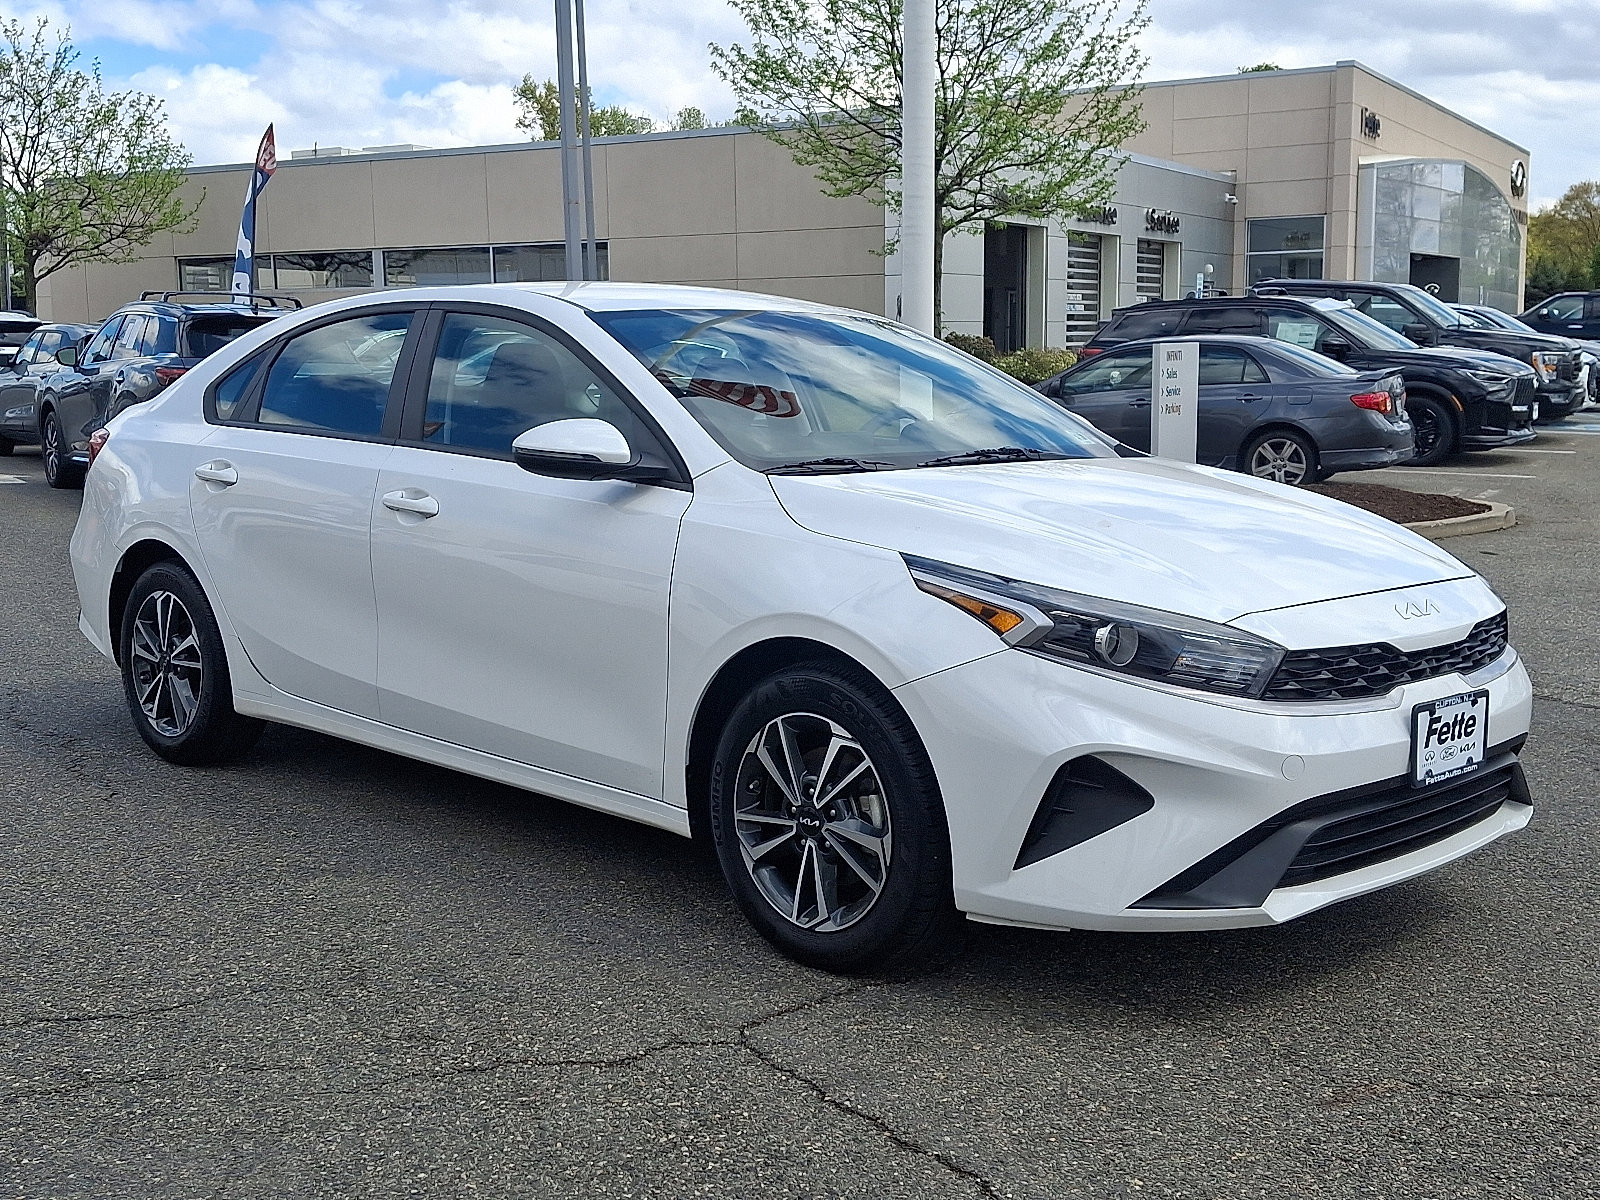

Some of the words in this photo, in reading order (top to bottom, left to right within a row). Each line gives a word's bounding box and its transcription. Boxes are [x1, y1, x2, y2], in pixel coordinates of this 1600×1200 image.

[1145, 208, 1180, 233] Service
[1166, 368, 1178, 380] Sales
[1165, 385, 1181, 397] Service
[1165, 403, 1182, 416] Parking
[1424, 711, 1477, 749] Fette
[1425, 764, 1478, 786] FetteAuto.com
